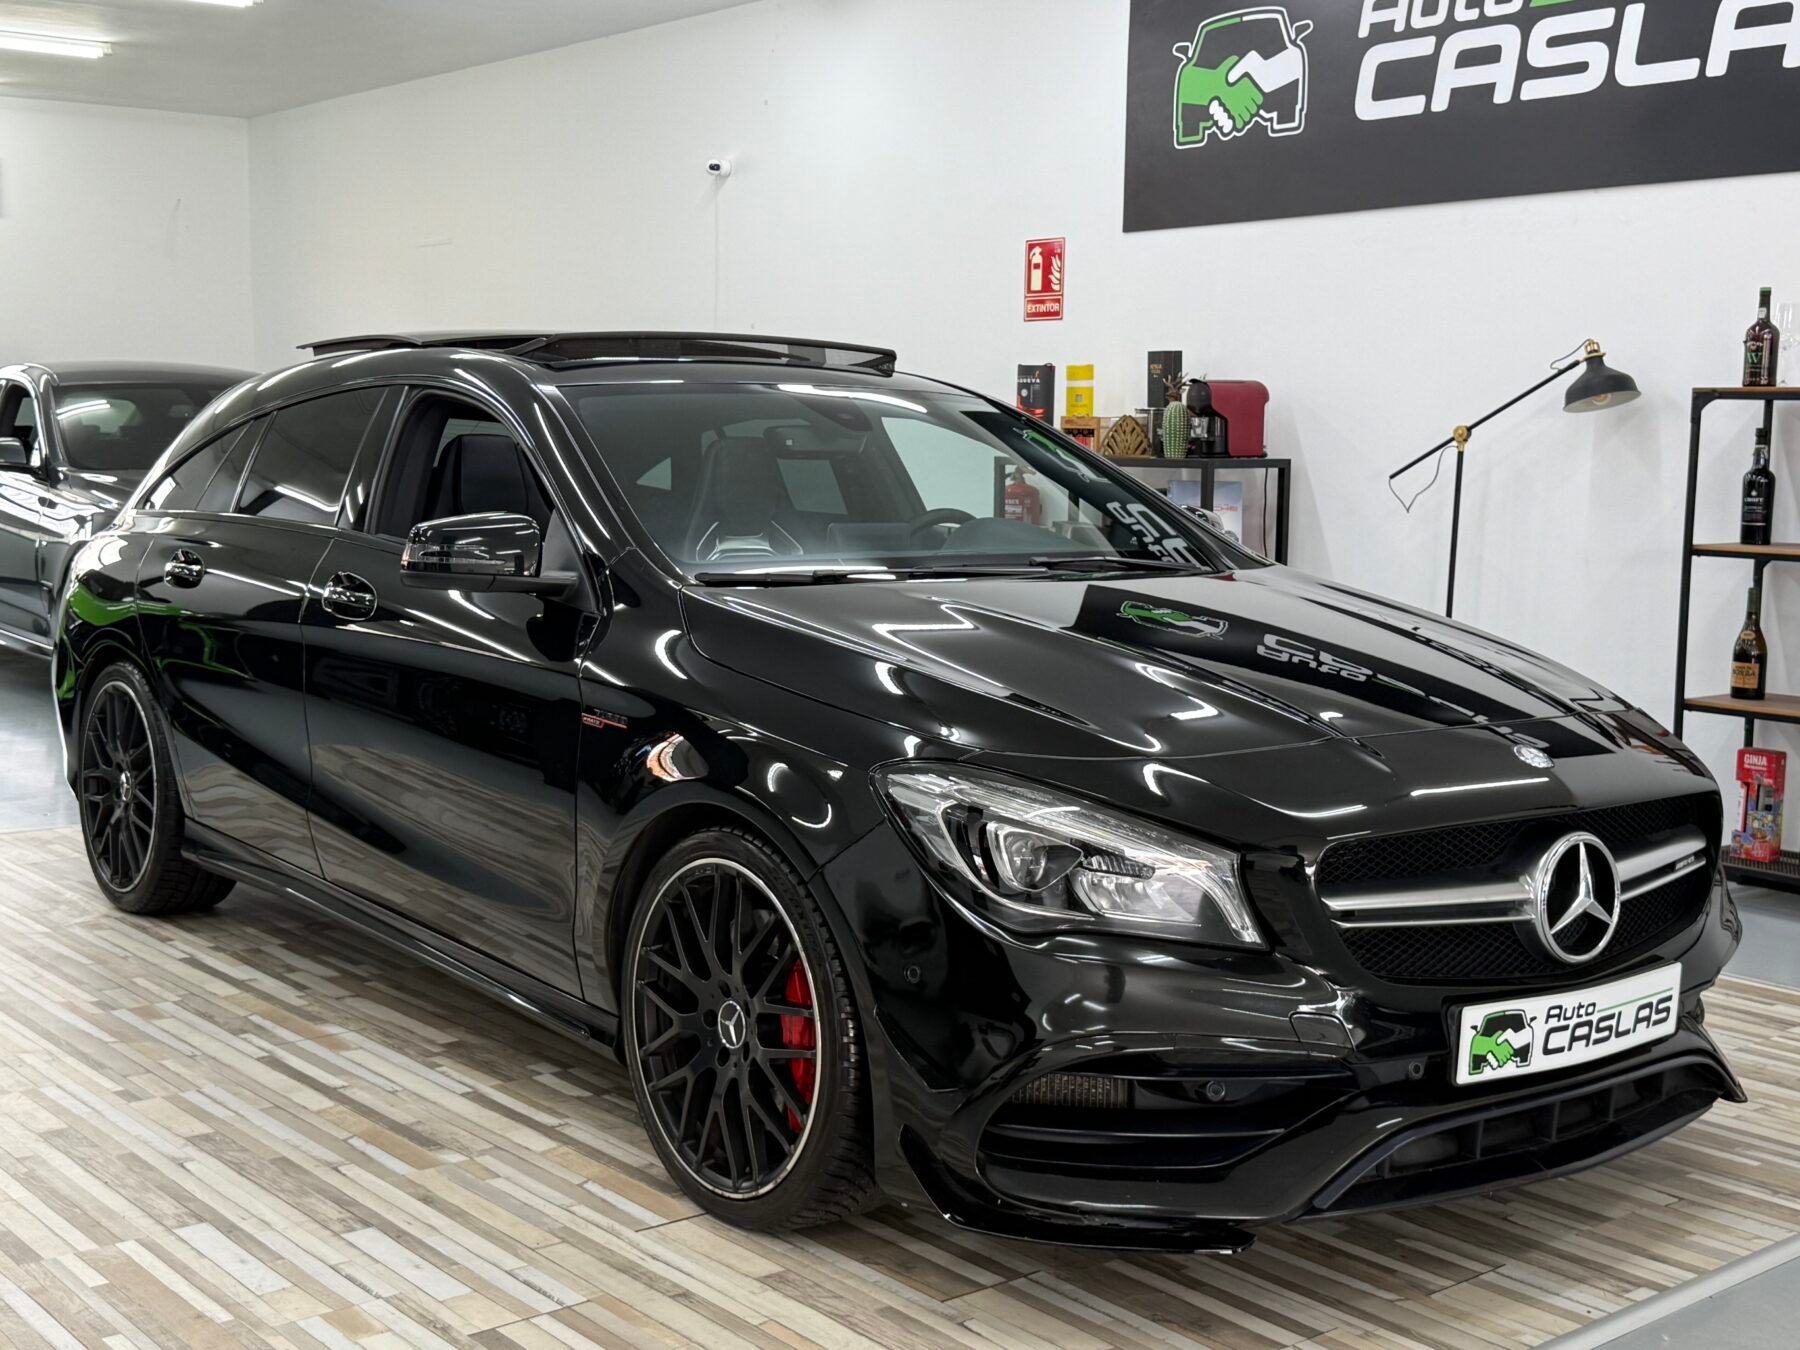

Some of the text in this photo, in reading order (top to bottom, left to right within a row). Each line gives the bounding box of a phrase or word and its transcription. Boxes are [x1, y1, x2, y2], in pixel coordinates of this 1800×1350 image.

[1027, 302, 1060, 313] EXTINTOR
[1744, 753, 1767, 766] GINJA
[1544, 1001, 1597, 1024] Auto
[1542, 994, 1673, 1056] CASLAS
